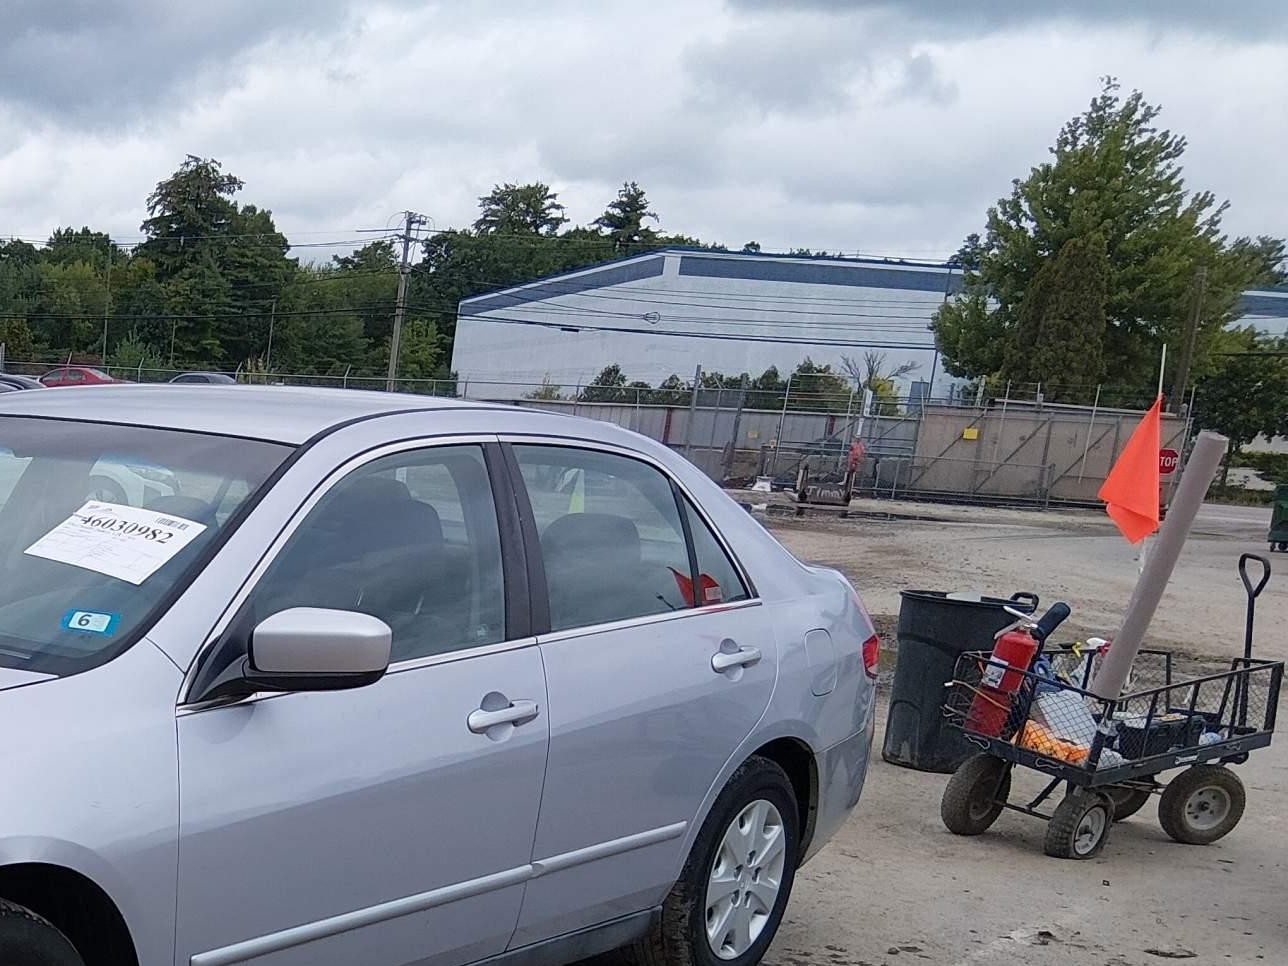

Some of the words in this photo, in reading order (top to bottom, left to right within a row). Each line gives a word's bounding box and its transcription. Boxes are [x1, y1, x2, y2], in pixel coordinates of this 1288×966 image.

[1159, 456, 1179, 467] TOP
[80, 514, 174, 544] 46030982
[77, 613, 92, 627] 6
